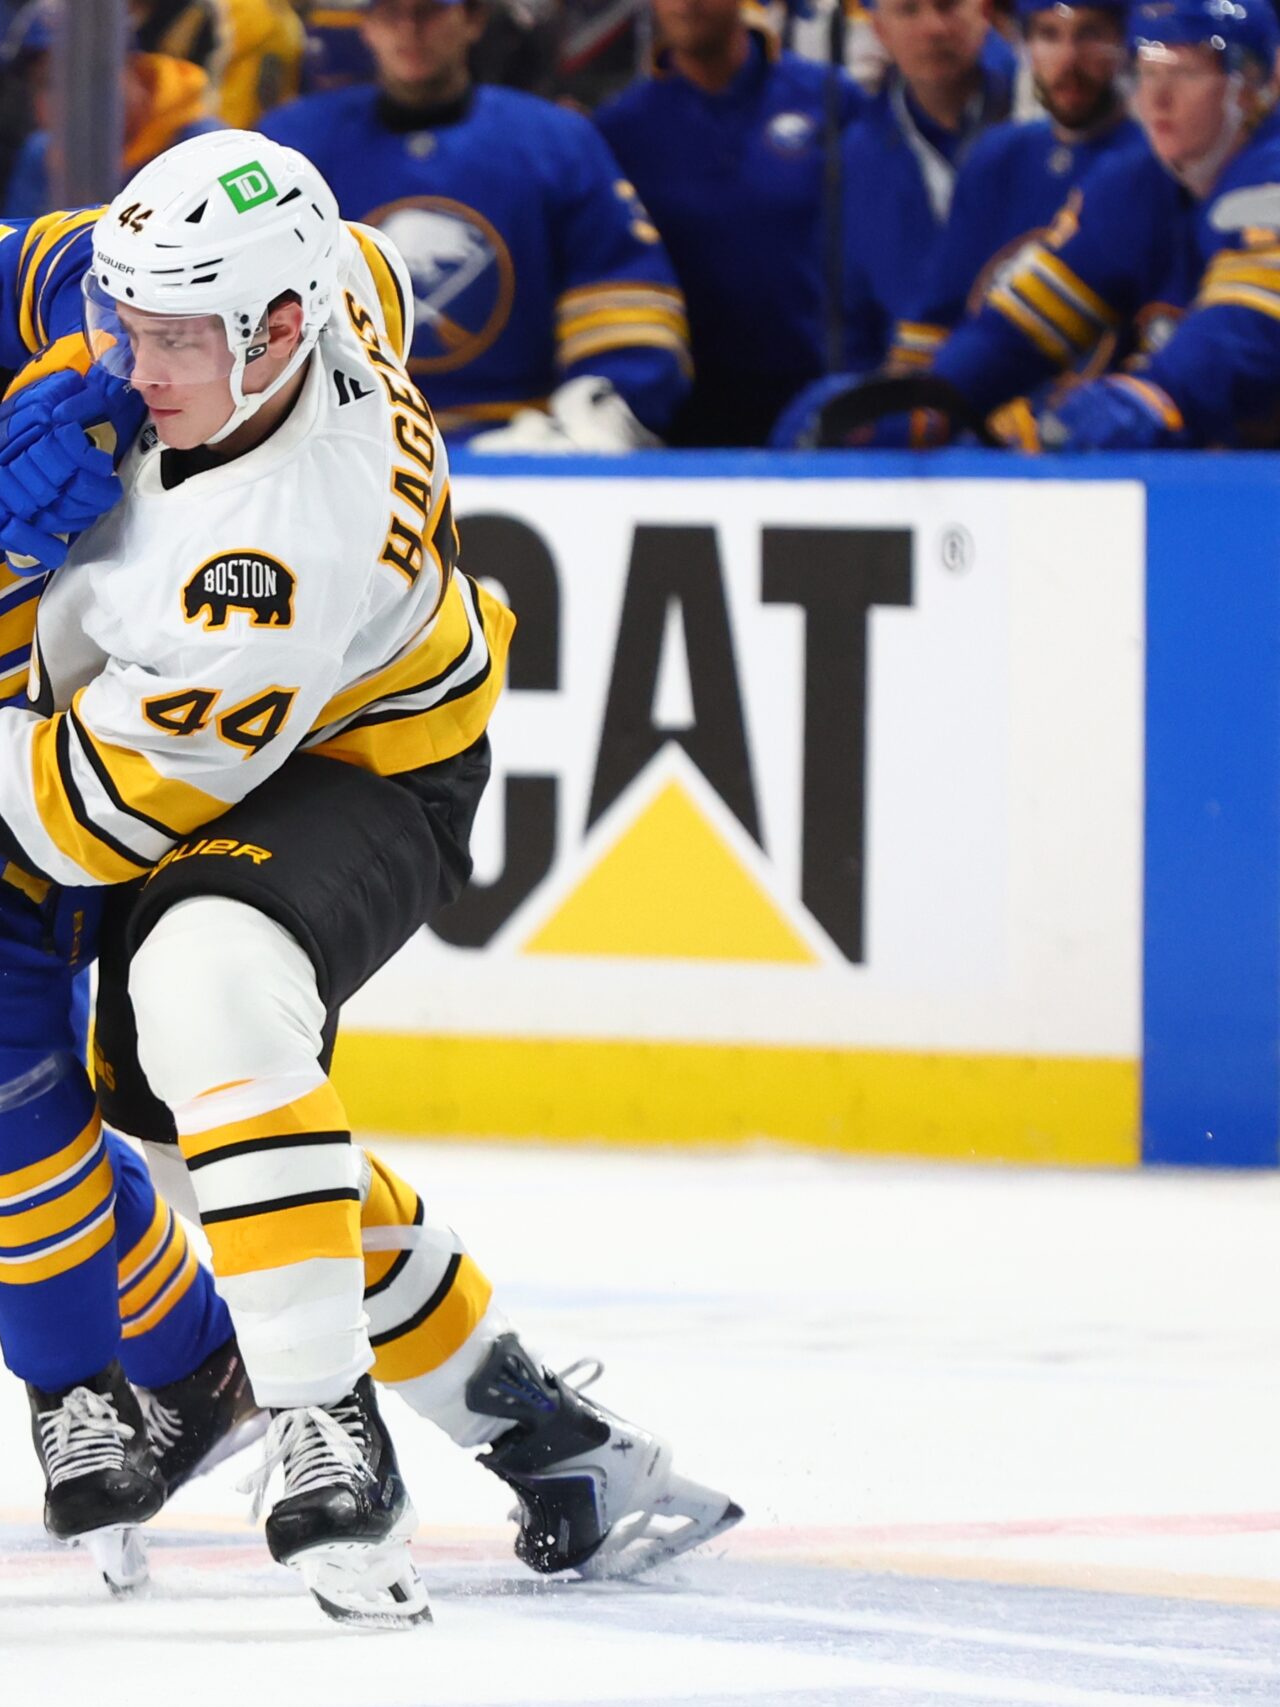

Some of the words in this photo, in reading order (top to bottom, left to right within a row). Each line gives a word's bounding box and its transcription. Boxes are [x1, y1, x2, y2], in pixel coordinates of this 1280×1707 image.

[227, 167, 270, 202] TD
[203, 559, 277, 599] BOSTON
[141, 685, 300, 761] 44
